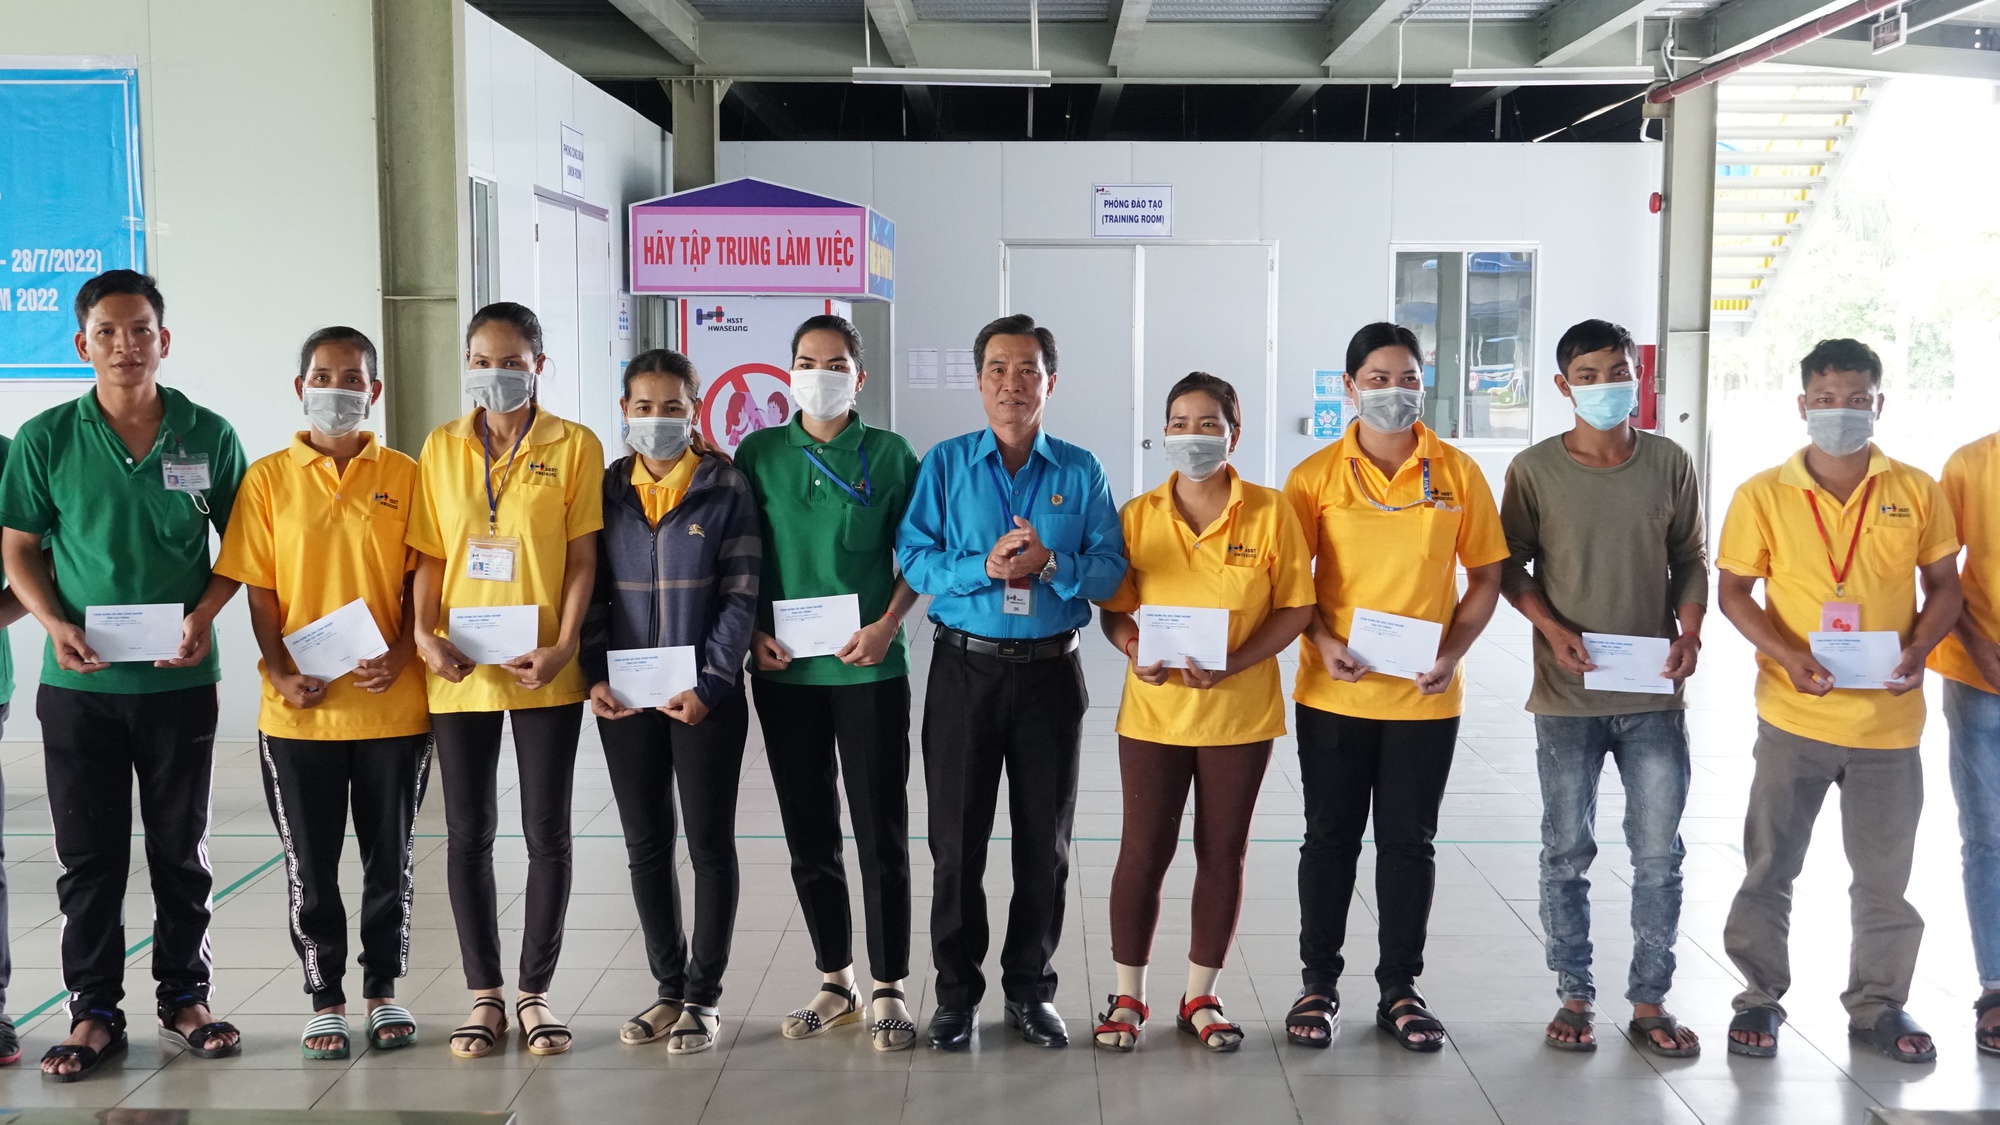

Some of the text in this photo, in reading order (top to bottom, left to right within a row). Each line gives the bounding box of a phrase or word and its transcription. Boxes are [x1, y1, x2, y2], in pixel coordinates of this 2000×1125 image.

[1103, 197, 1163, 211] PHÒNG ĐÀO TẠO
[1101, 214, 1164, 225] (TRAINING ROOM)
[11, 248, 102, 275] 28/7/2022)
[643, 229, 675, 265] HÃY
[680, 229, 711, 273] TẬP
[716, 236, 771, 266] TRUNG
[776, 229, 811, 266] LÀM
[816, 230, 854, 273] VIỆC
[16, 288, 59, 312] 2022
[308, 949, 321, 987] WRLDWD
